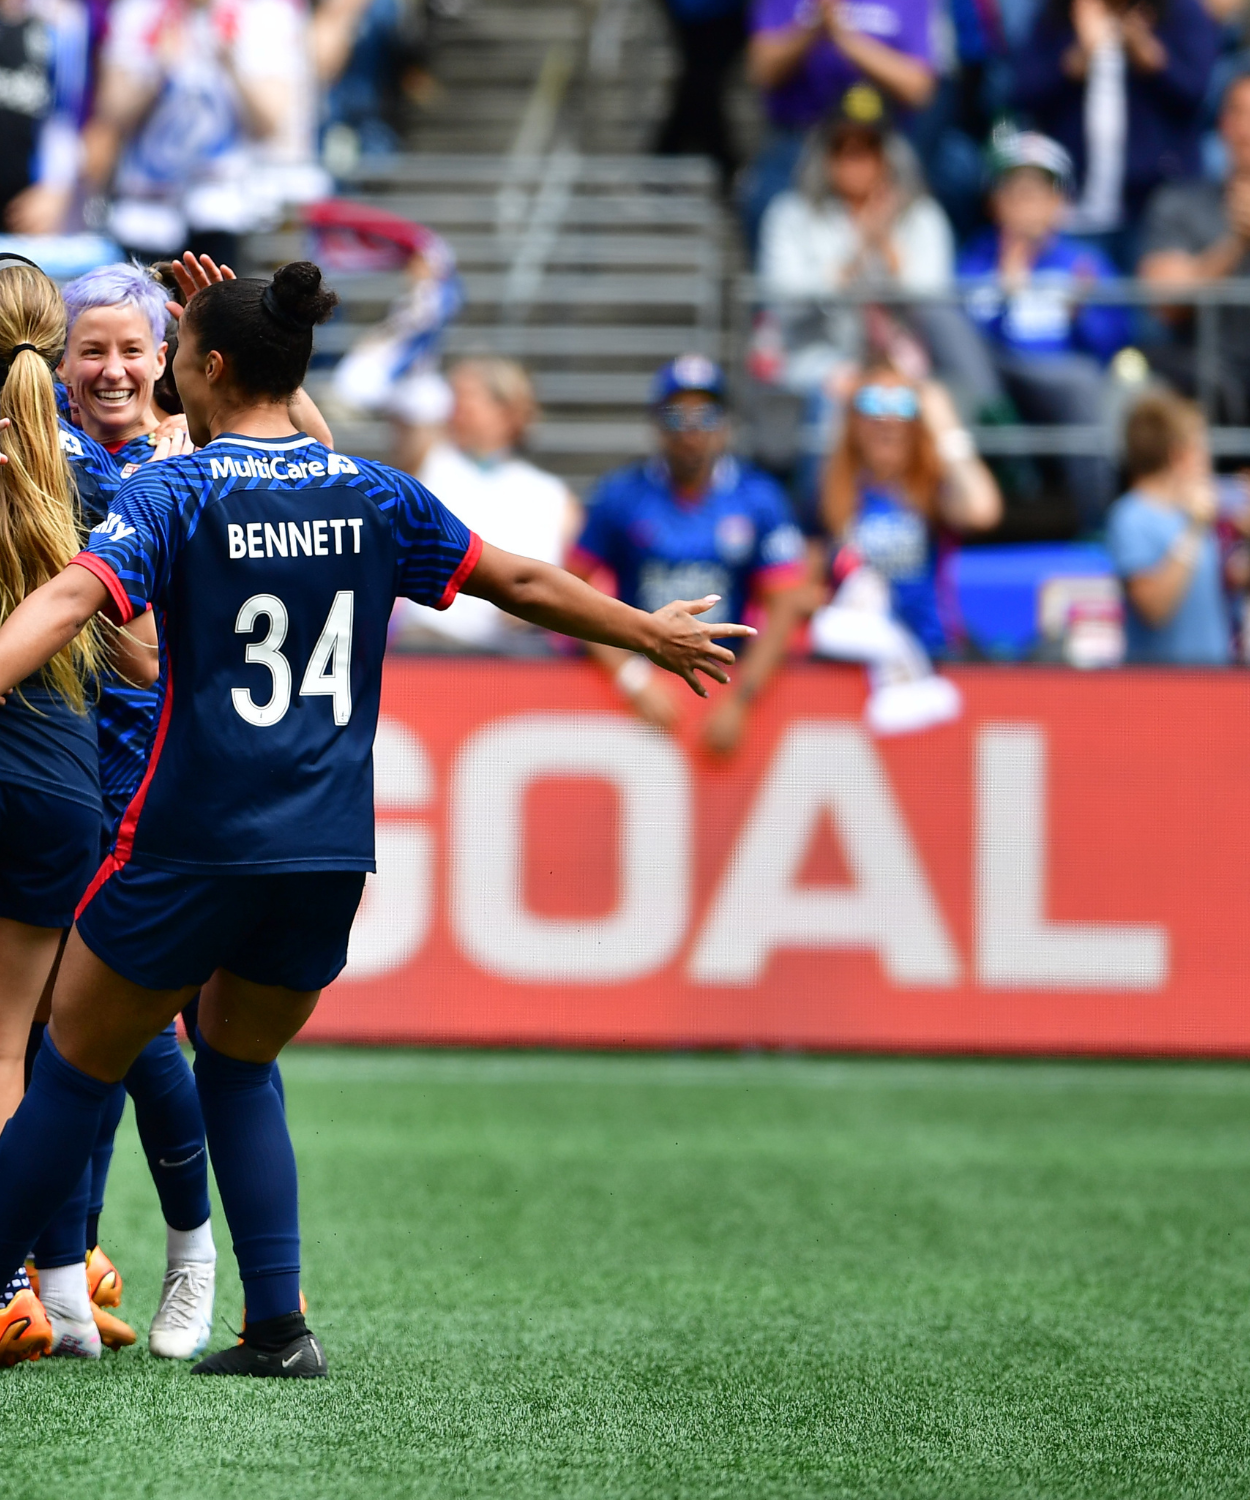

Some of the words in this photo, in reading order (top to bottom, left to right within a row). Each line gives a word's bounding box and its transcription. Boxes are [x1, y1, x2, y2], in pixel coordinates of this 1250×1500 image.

[210, 455, 326, 480] MultiCare
[227, 518, 364, 559] BENNETT
[231, 590, 354, 727] 34
